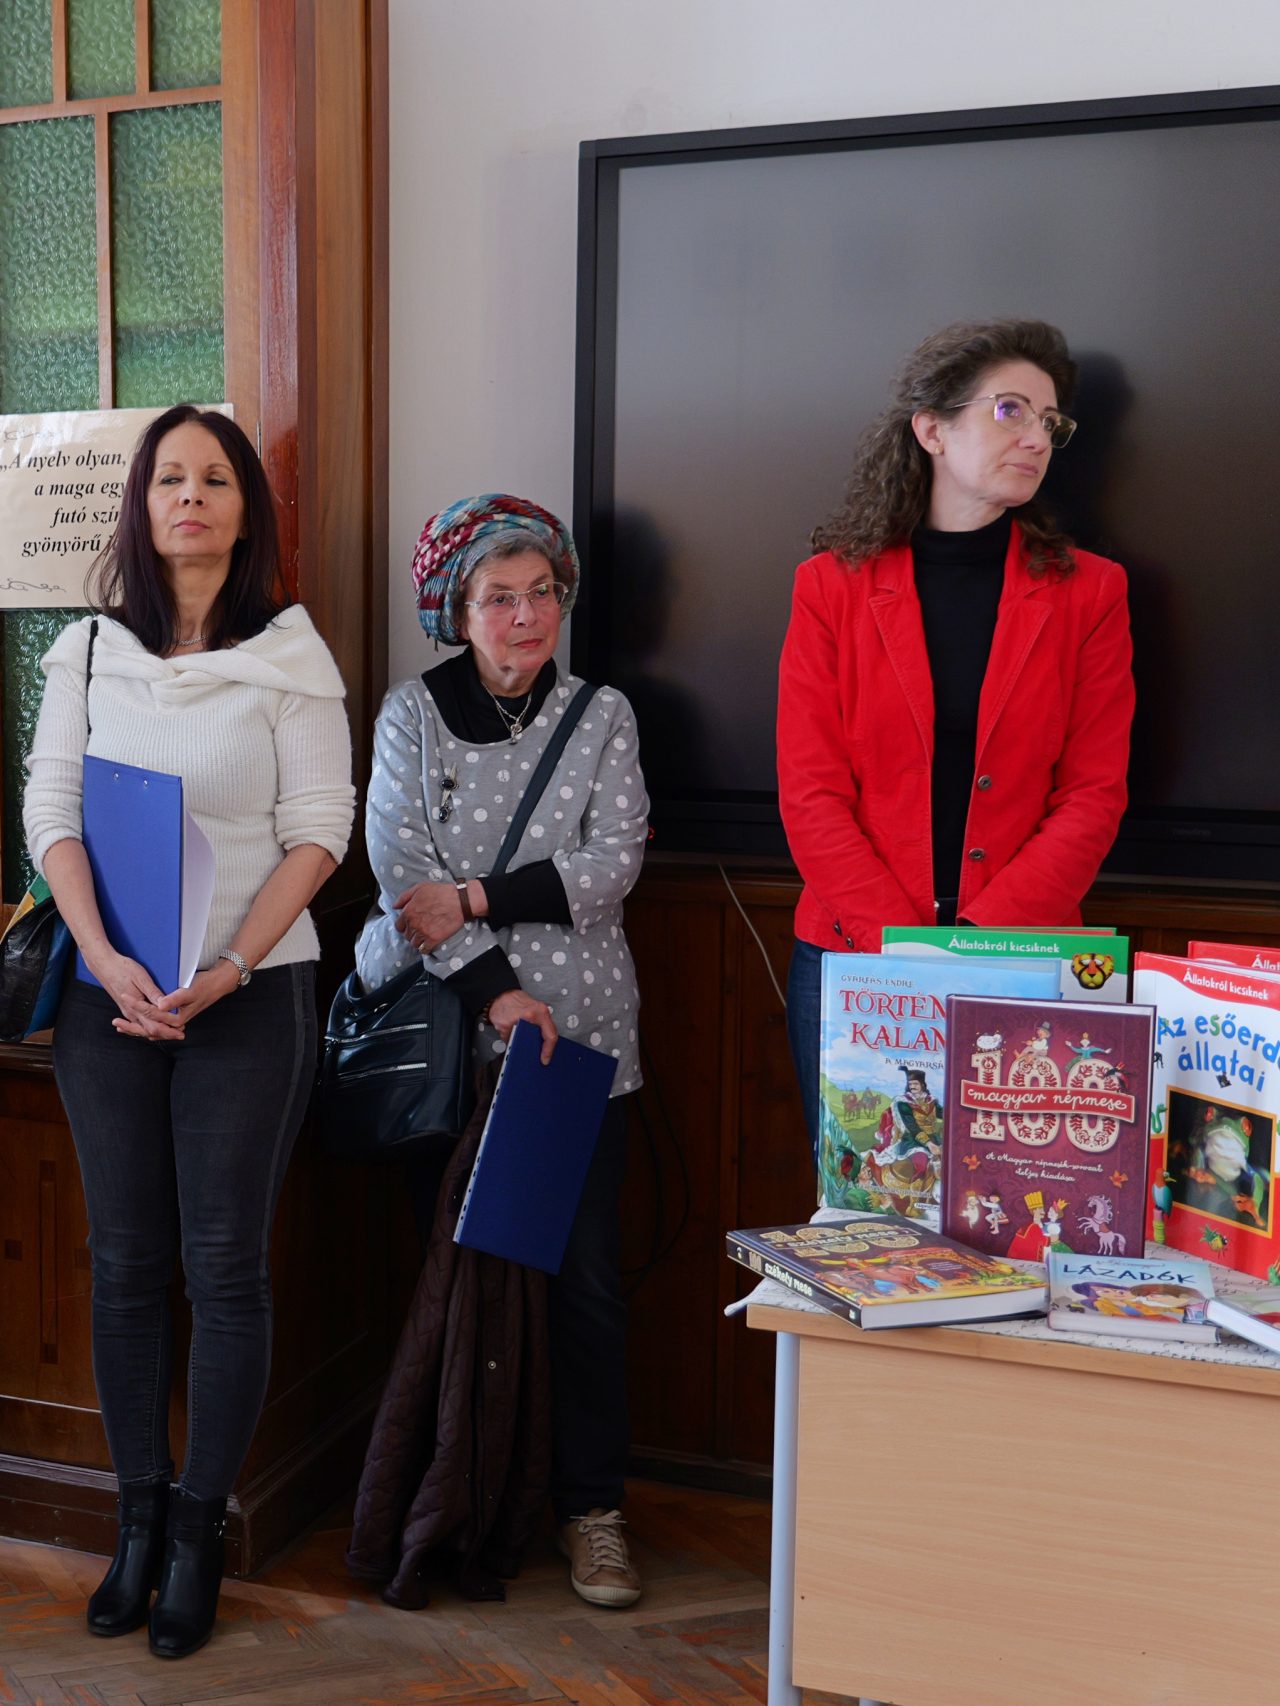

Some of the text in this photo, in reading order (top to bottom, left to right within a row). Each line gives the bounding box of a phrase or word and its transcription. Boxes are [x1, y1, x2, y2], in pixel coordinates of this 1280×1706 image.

[28, 450, 70, 472] nyelv
[75, 449, 126, 471] olyan,
[34, 484, 44, 496] a
[49, 483, 95, 500] maga
[50, 506, 86, 528] futó
[21, 534, 101, 557] gyönyörű
[948, 934, 1060, 953] Állatokról kicsiknek
[1183, 967, 1269, 1001] Állatokról kicsiknek
[1157, 1013, 1280, 1068] Az esőerd
[1177, 1040, 1265, 1092] állatai
[967, 1088, 1127, 1111] magyar népmese
[970, 1050, 1120, 1153] 100
[997, 1153, 1033, 1165] Magyar
[1015, 1167, 1076, 1182] teljes kiadása
[764, 1262, 793, 1288] székely
[793, 1277, 813, 1297] mese
[1062, 1264, 1197, 1284] LÁZADÓK
